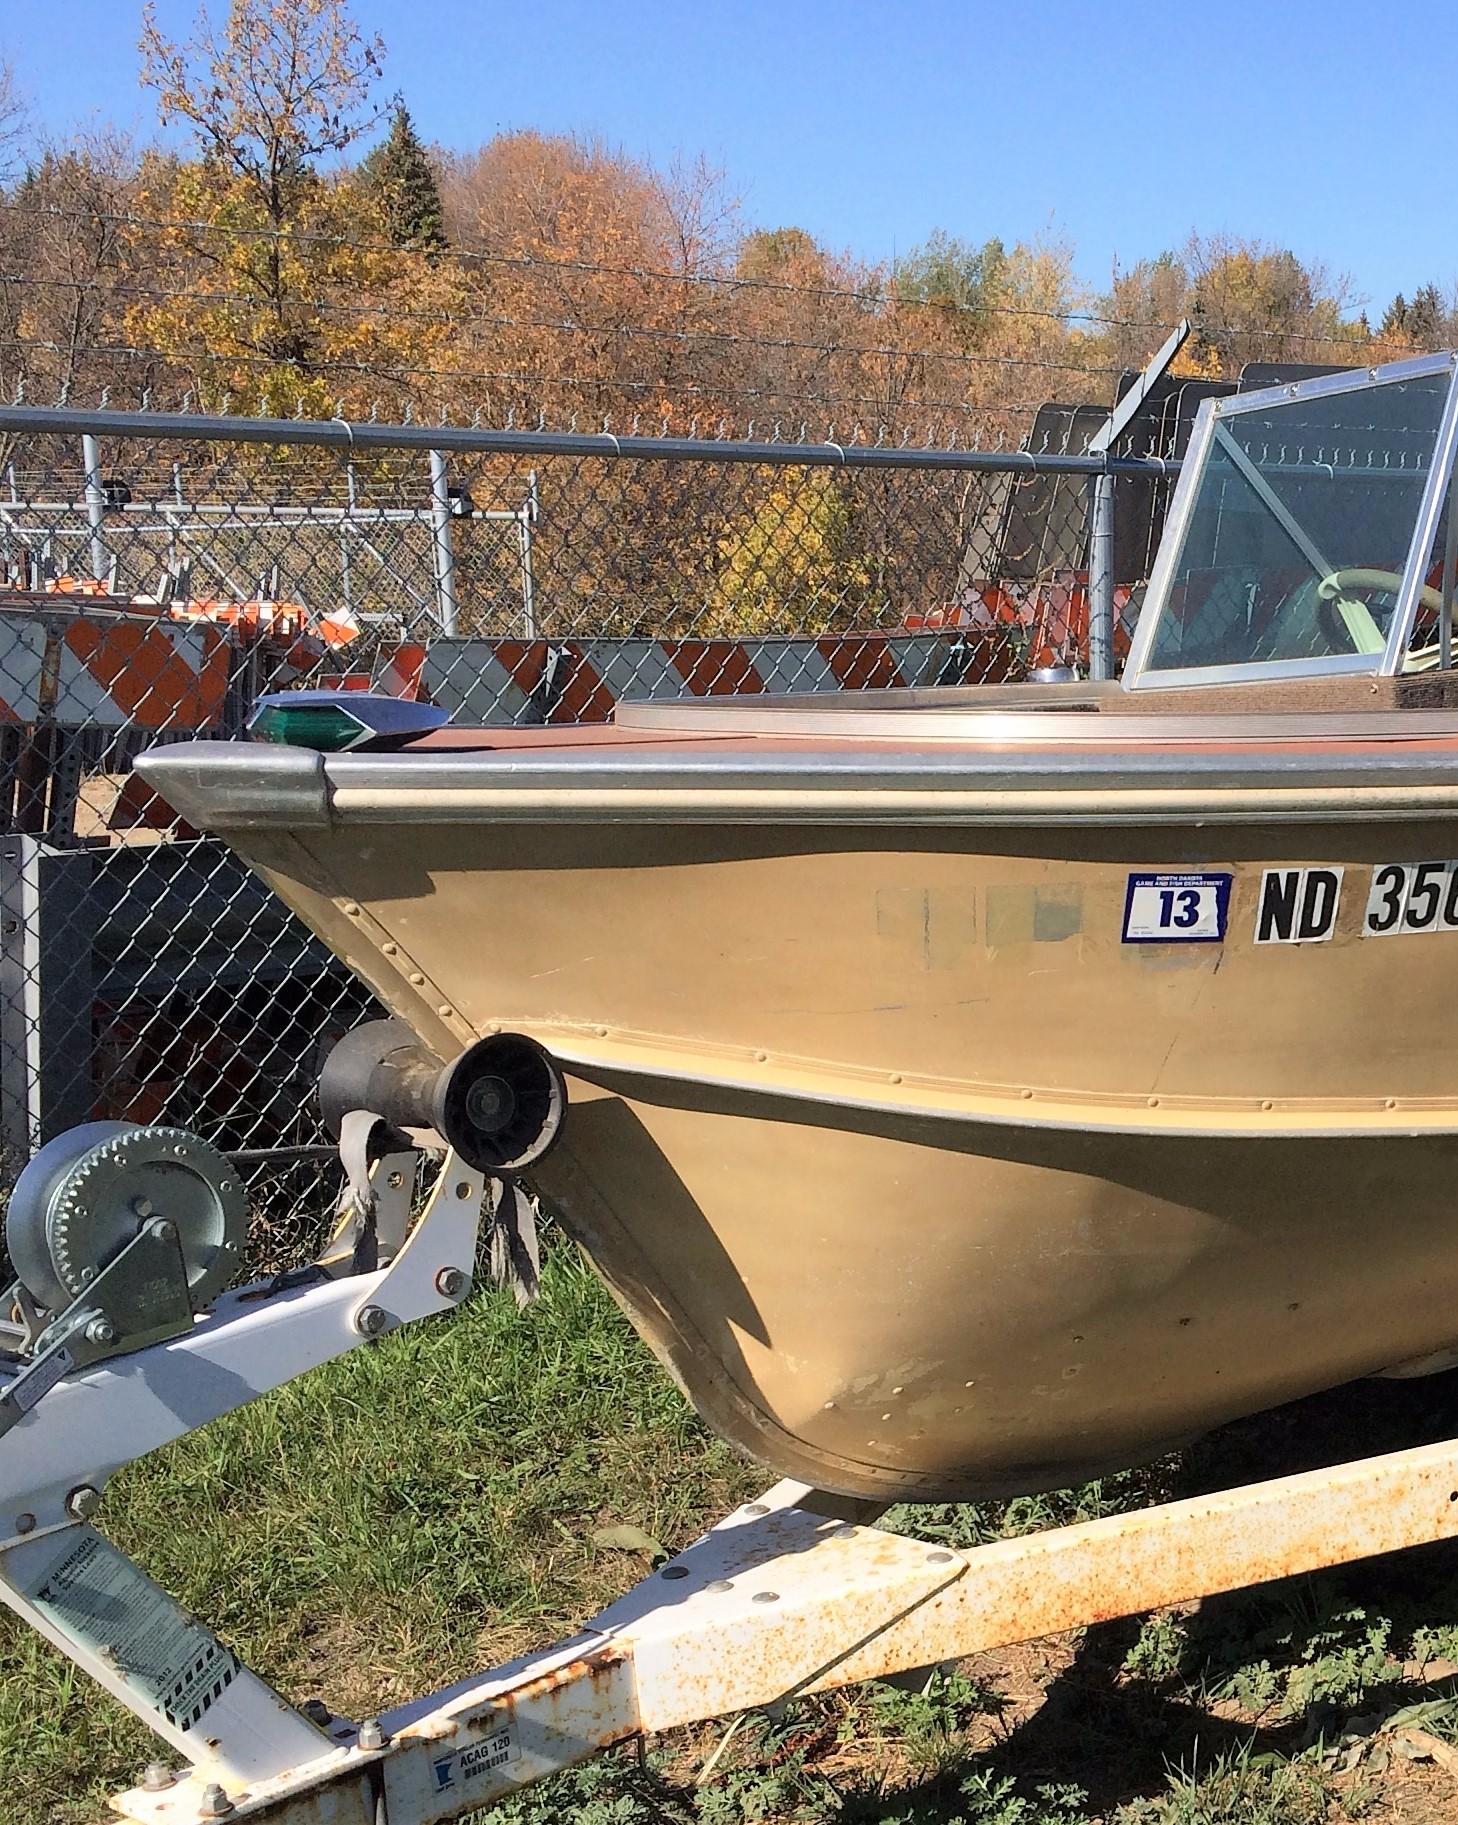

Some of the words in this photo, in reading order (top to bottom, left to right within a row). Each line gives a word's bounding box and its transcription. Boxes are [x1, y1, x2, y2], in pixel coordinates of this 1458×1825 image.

[1159, 889, 1201, 928] 13
[1258, 869, 1338, 942] ND
[51, 1537, 95, 1581] MINNESOTA
[460, 1746, 489, 1768] ACAG
[492, 1735, 511, 1752] 120
